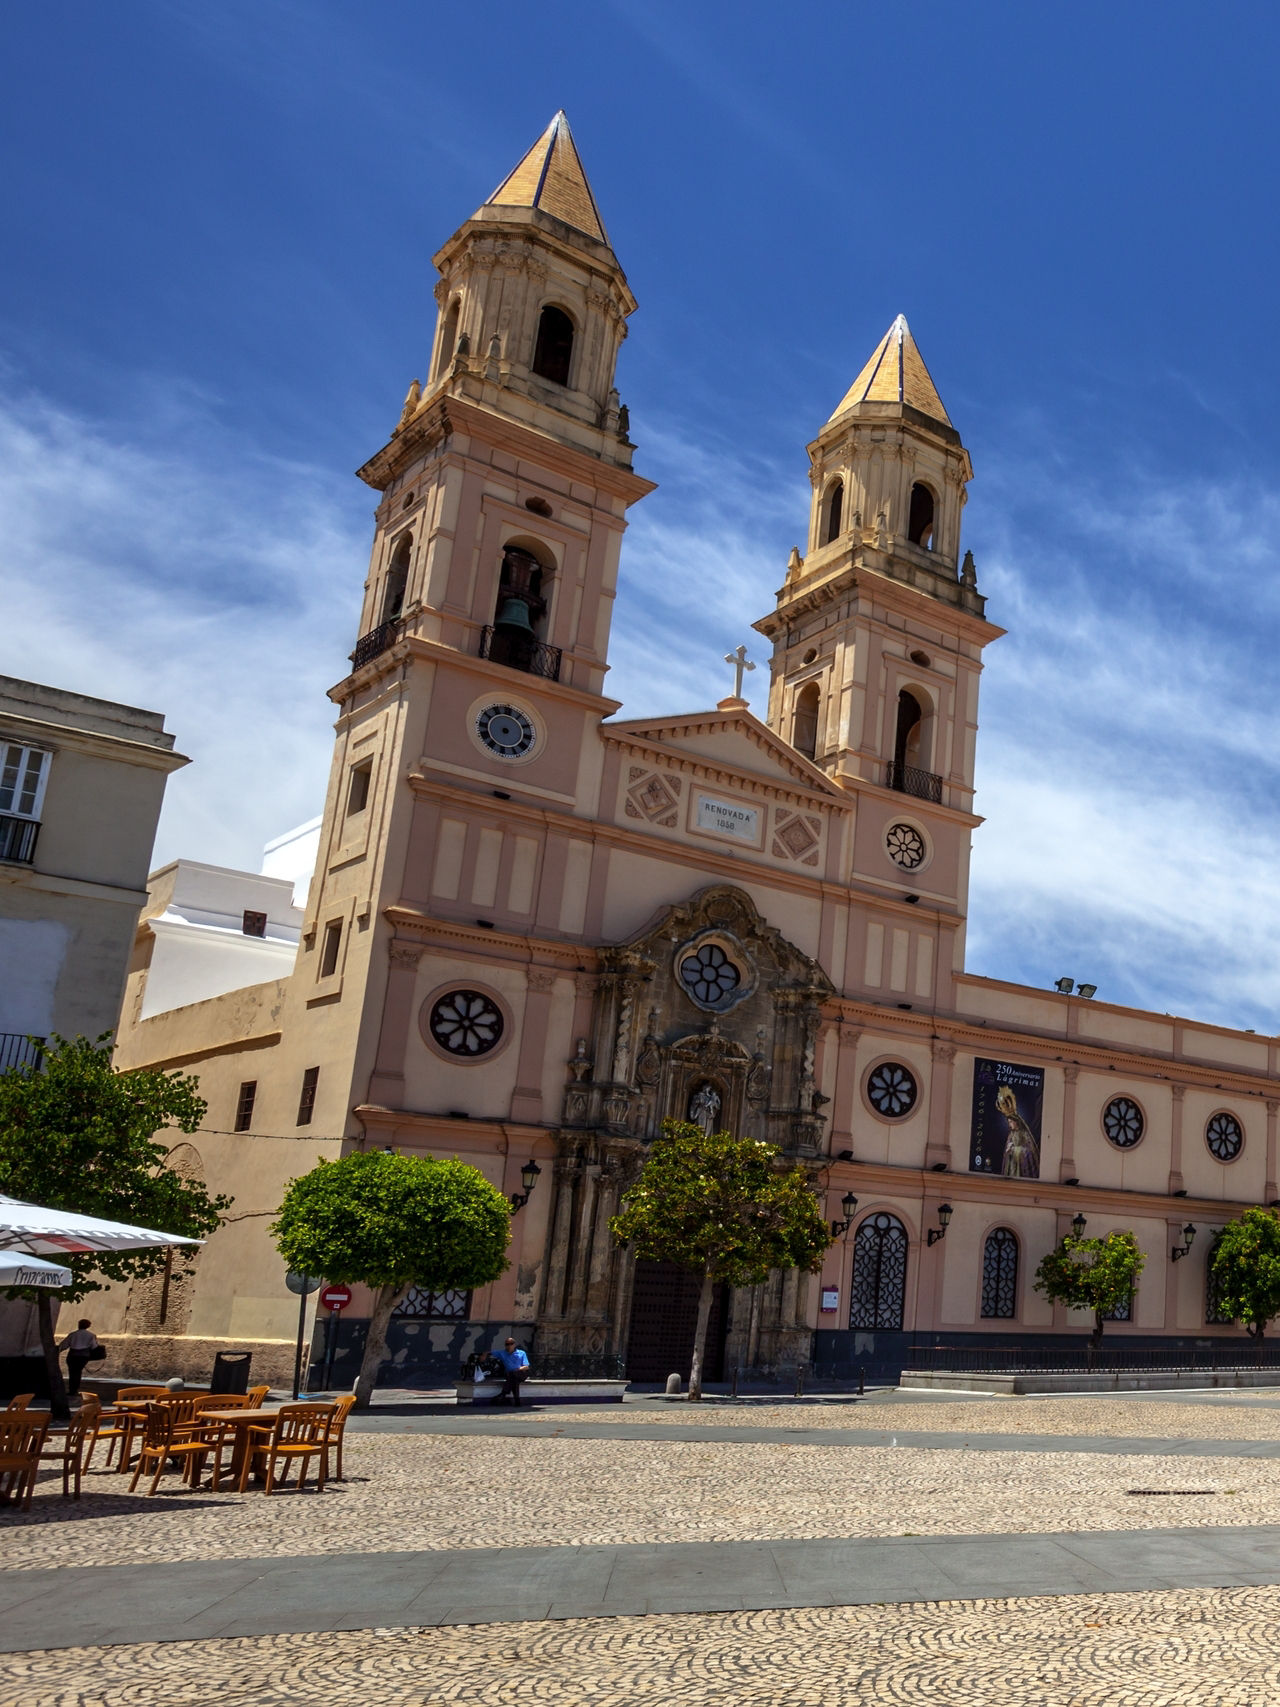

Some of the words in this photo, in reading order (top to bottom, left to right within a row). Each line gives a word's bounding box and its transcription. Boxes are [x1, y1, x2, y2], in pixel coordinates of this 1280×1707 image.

[705, 803, 750, 822] RENOVADA
[996, 1064, 1012, 1075] 250
[1011, 1070, 1040, 1080] Aniversario
[996, 1073, 1039, 1087] Lágrimas
